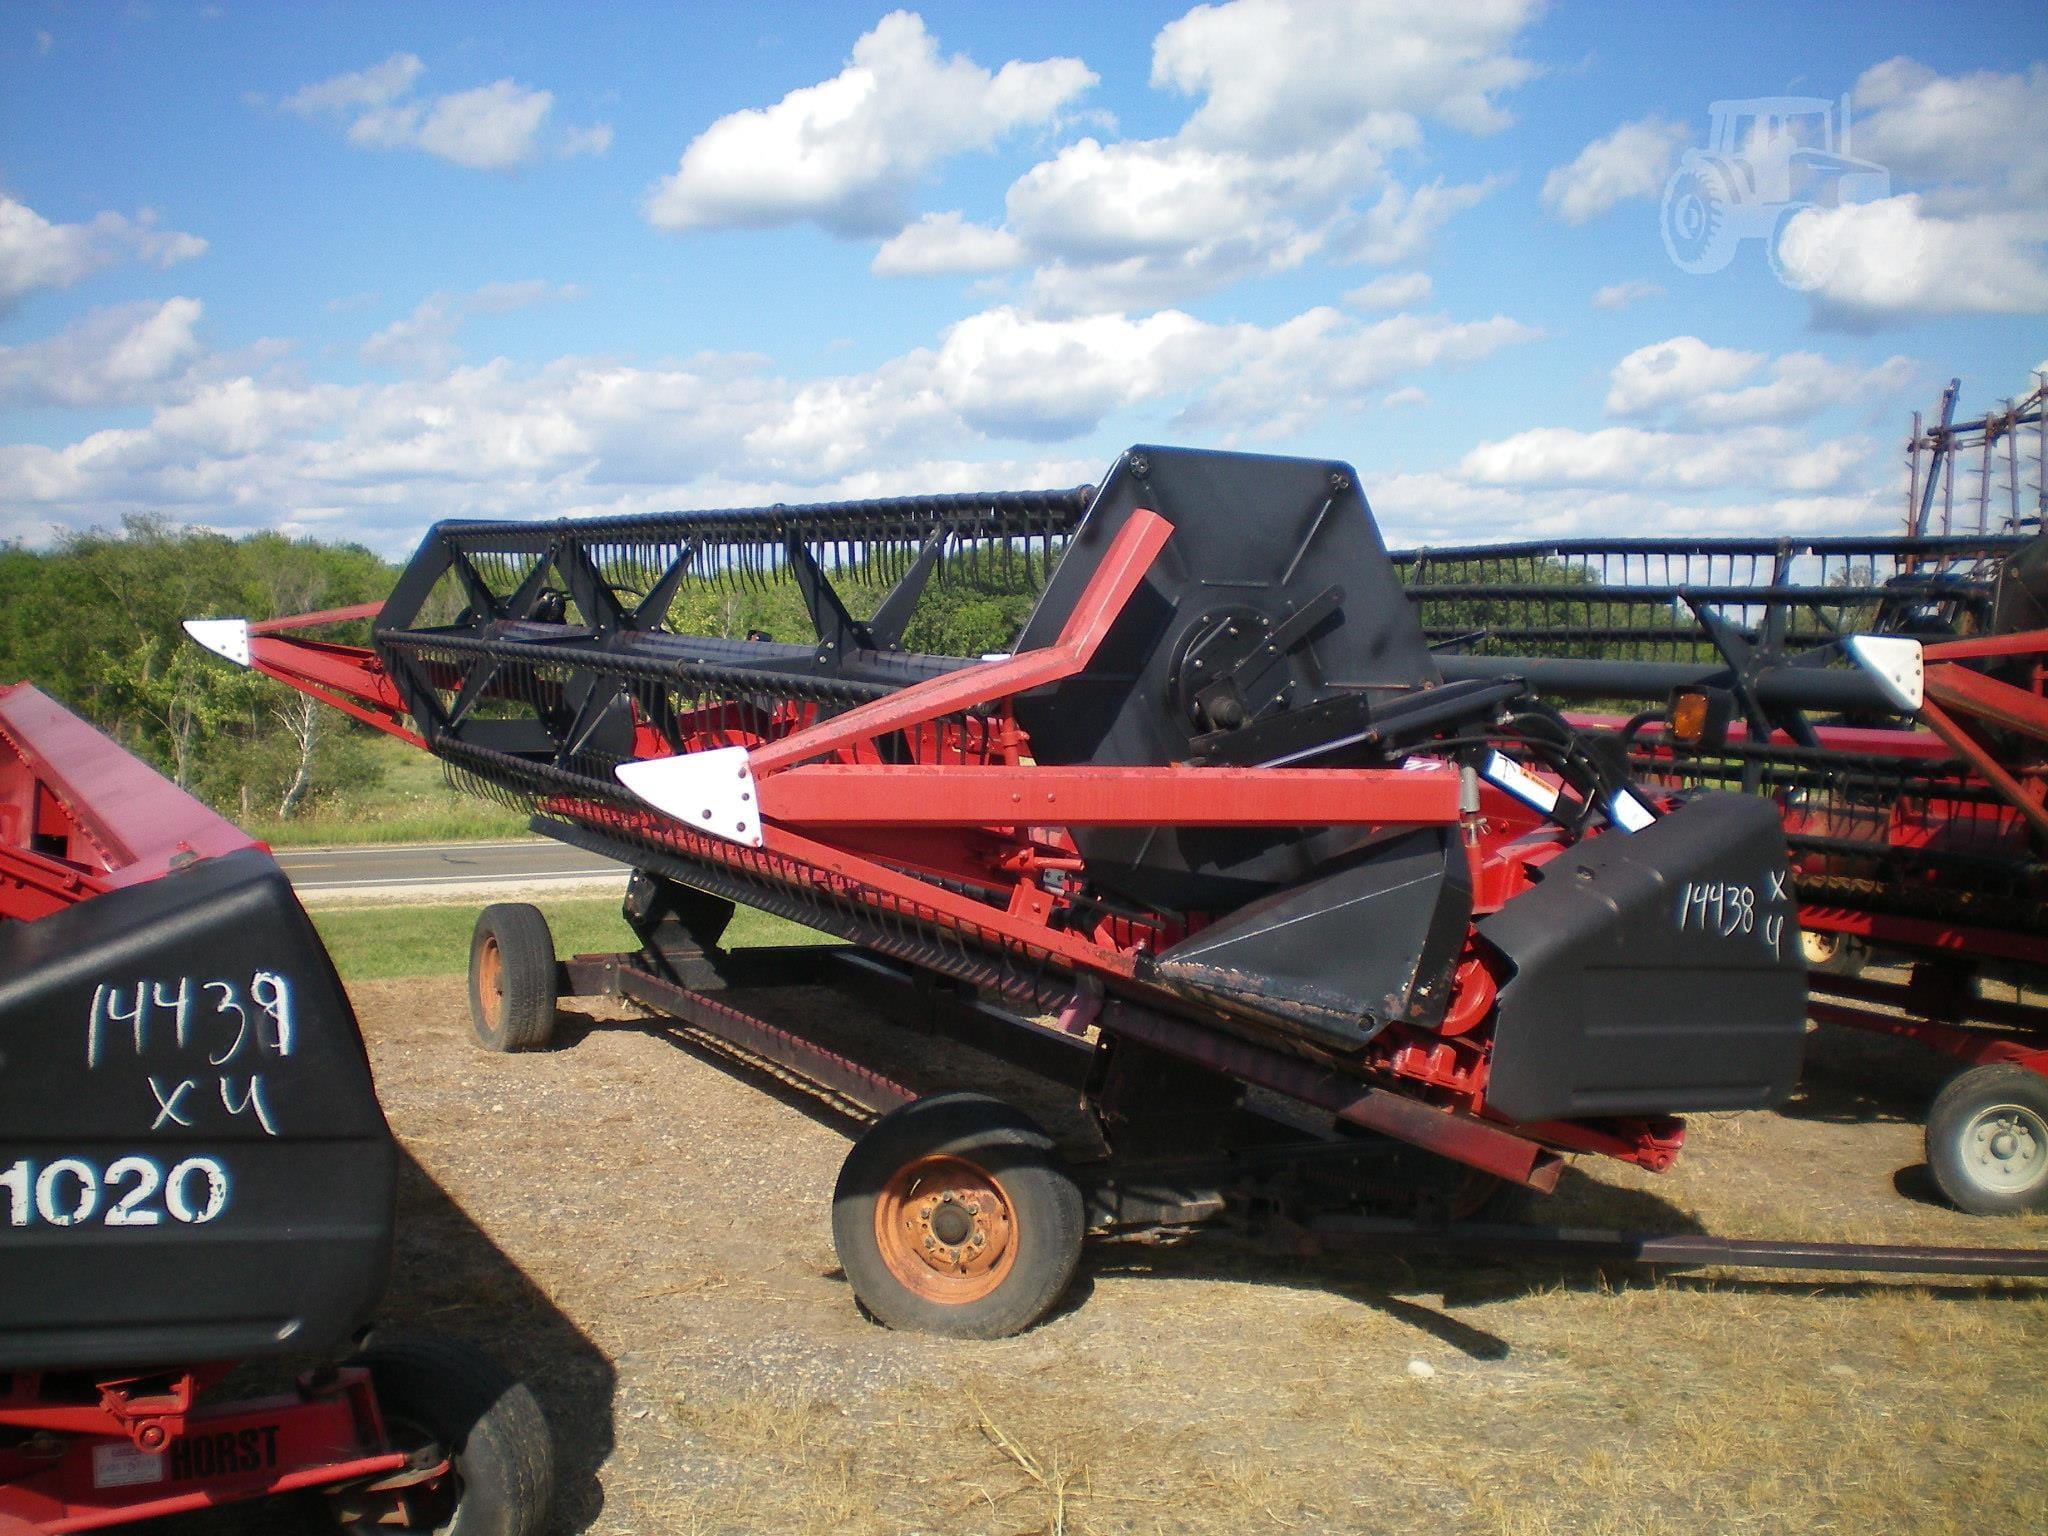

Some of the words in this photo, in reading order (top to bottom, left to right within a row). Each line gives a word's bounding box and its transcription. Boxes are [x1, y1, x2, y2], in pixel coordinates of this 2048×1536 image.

[1680, 881, 1755, 937] 14438
[87, 968, 290, 1070] 14439
[0, 1156, 228, 1227] 1020
[171, 1425, 280, 1482] HORST
